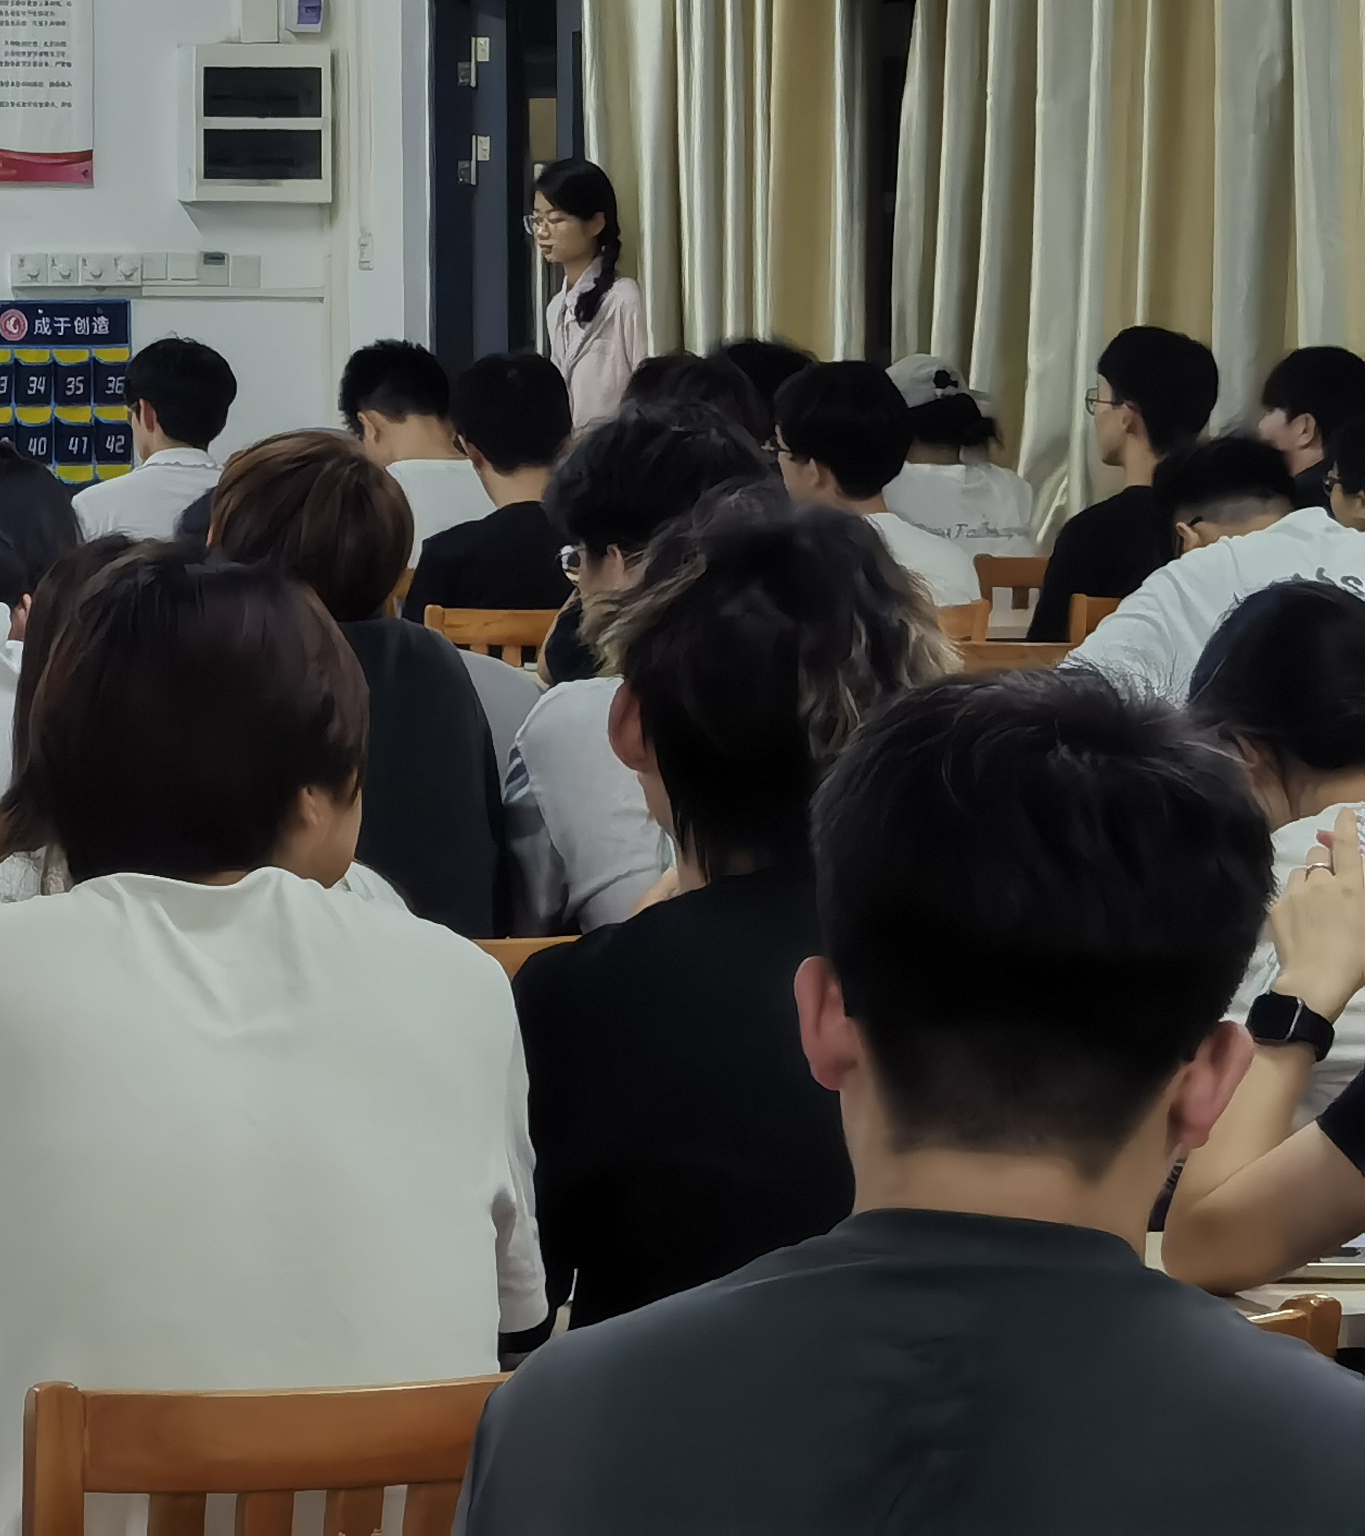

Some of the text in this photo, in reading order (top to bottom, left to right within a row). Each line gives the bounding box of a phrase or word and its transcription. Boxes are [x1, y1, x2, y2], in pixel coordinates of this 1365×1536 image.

[33, 316, 110, 335] 成于创造
[26, 376, 46, 395] 34
[65, 376, 84, 395] 35
[105, 376, 125, 395] 36
[28, 437, 47, 455] 40
[68, 436, 88, 455] 41
[105, 435, 125, 454] 42
